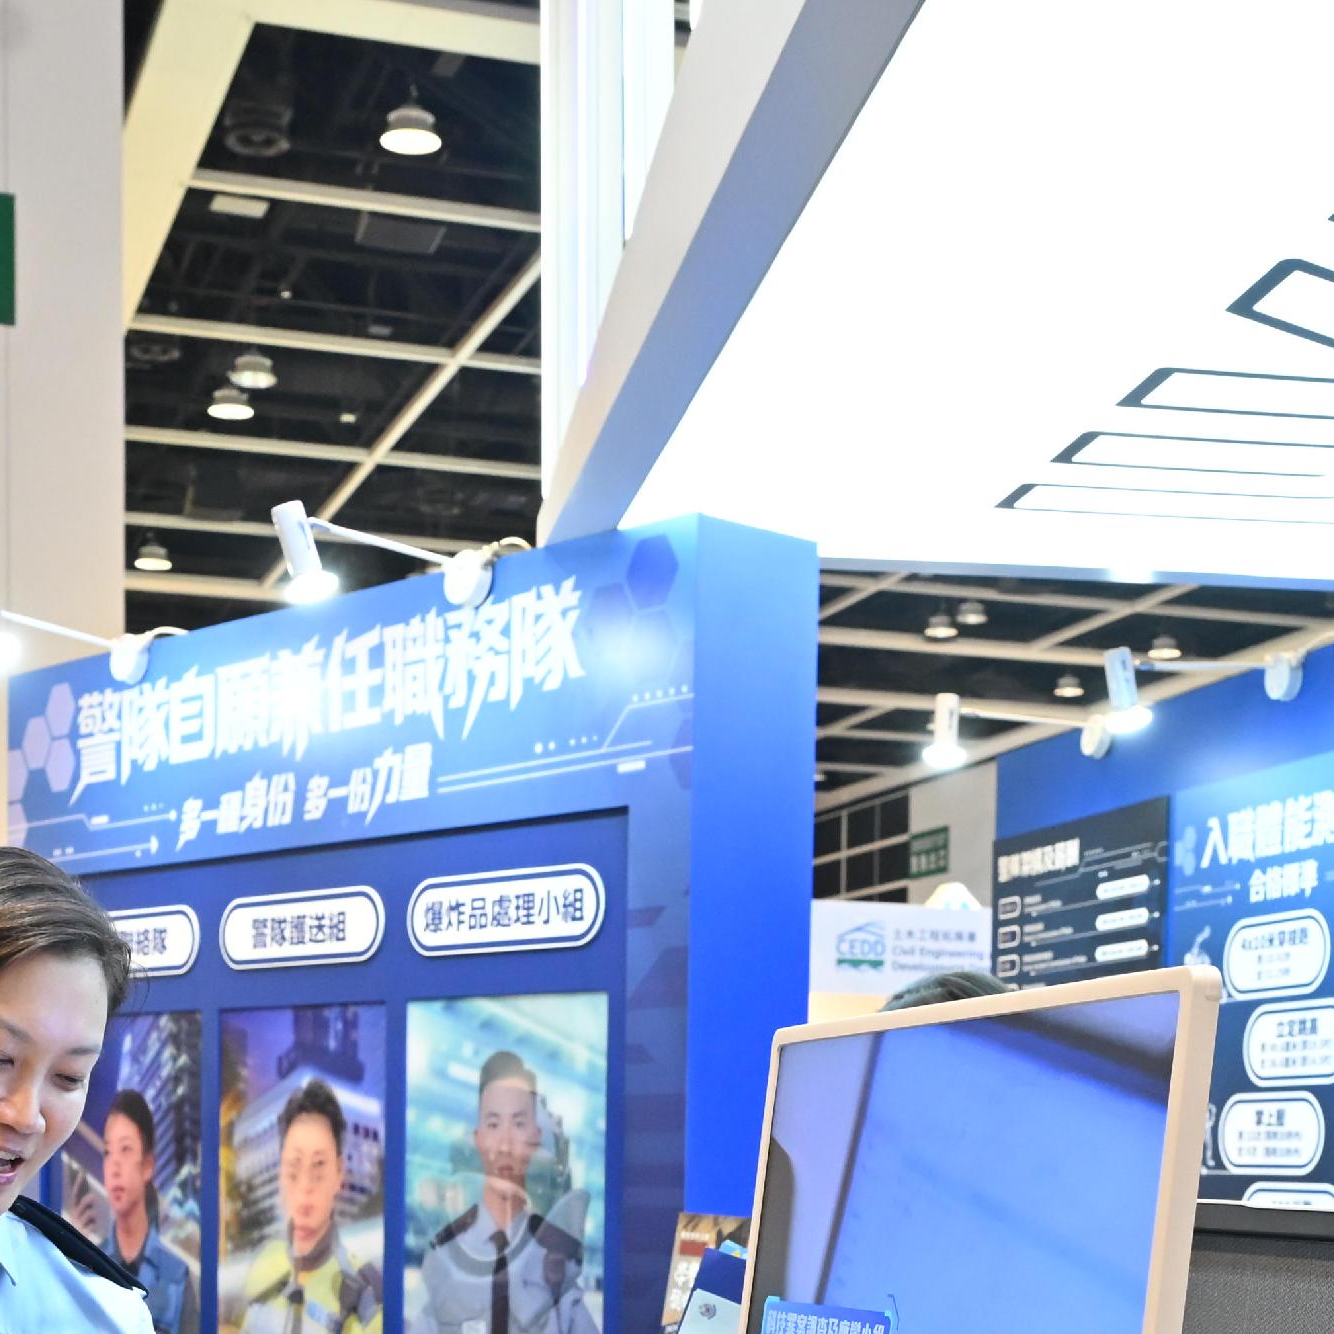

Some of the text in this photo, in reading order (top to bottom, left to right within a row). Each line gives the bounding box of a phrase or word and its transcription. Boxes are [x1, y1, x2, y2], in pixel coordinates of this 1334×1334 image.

[304, 742, 432, 826] 多一份力量
[251, 911, 346, 949] 警隊護送組
[424, 888, 584, 932] 爆炸品處理小組
[837, 938, 885, 957] CEDD
